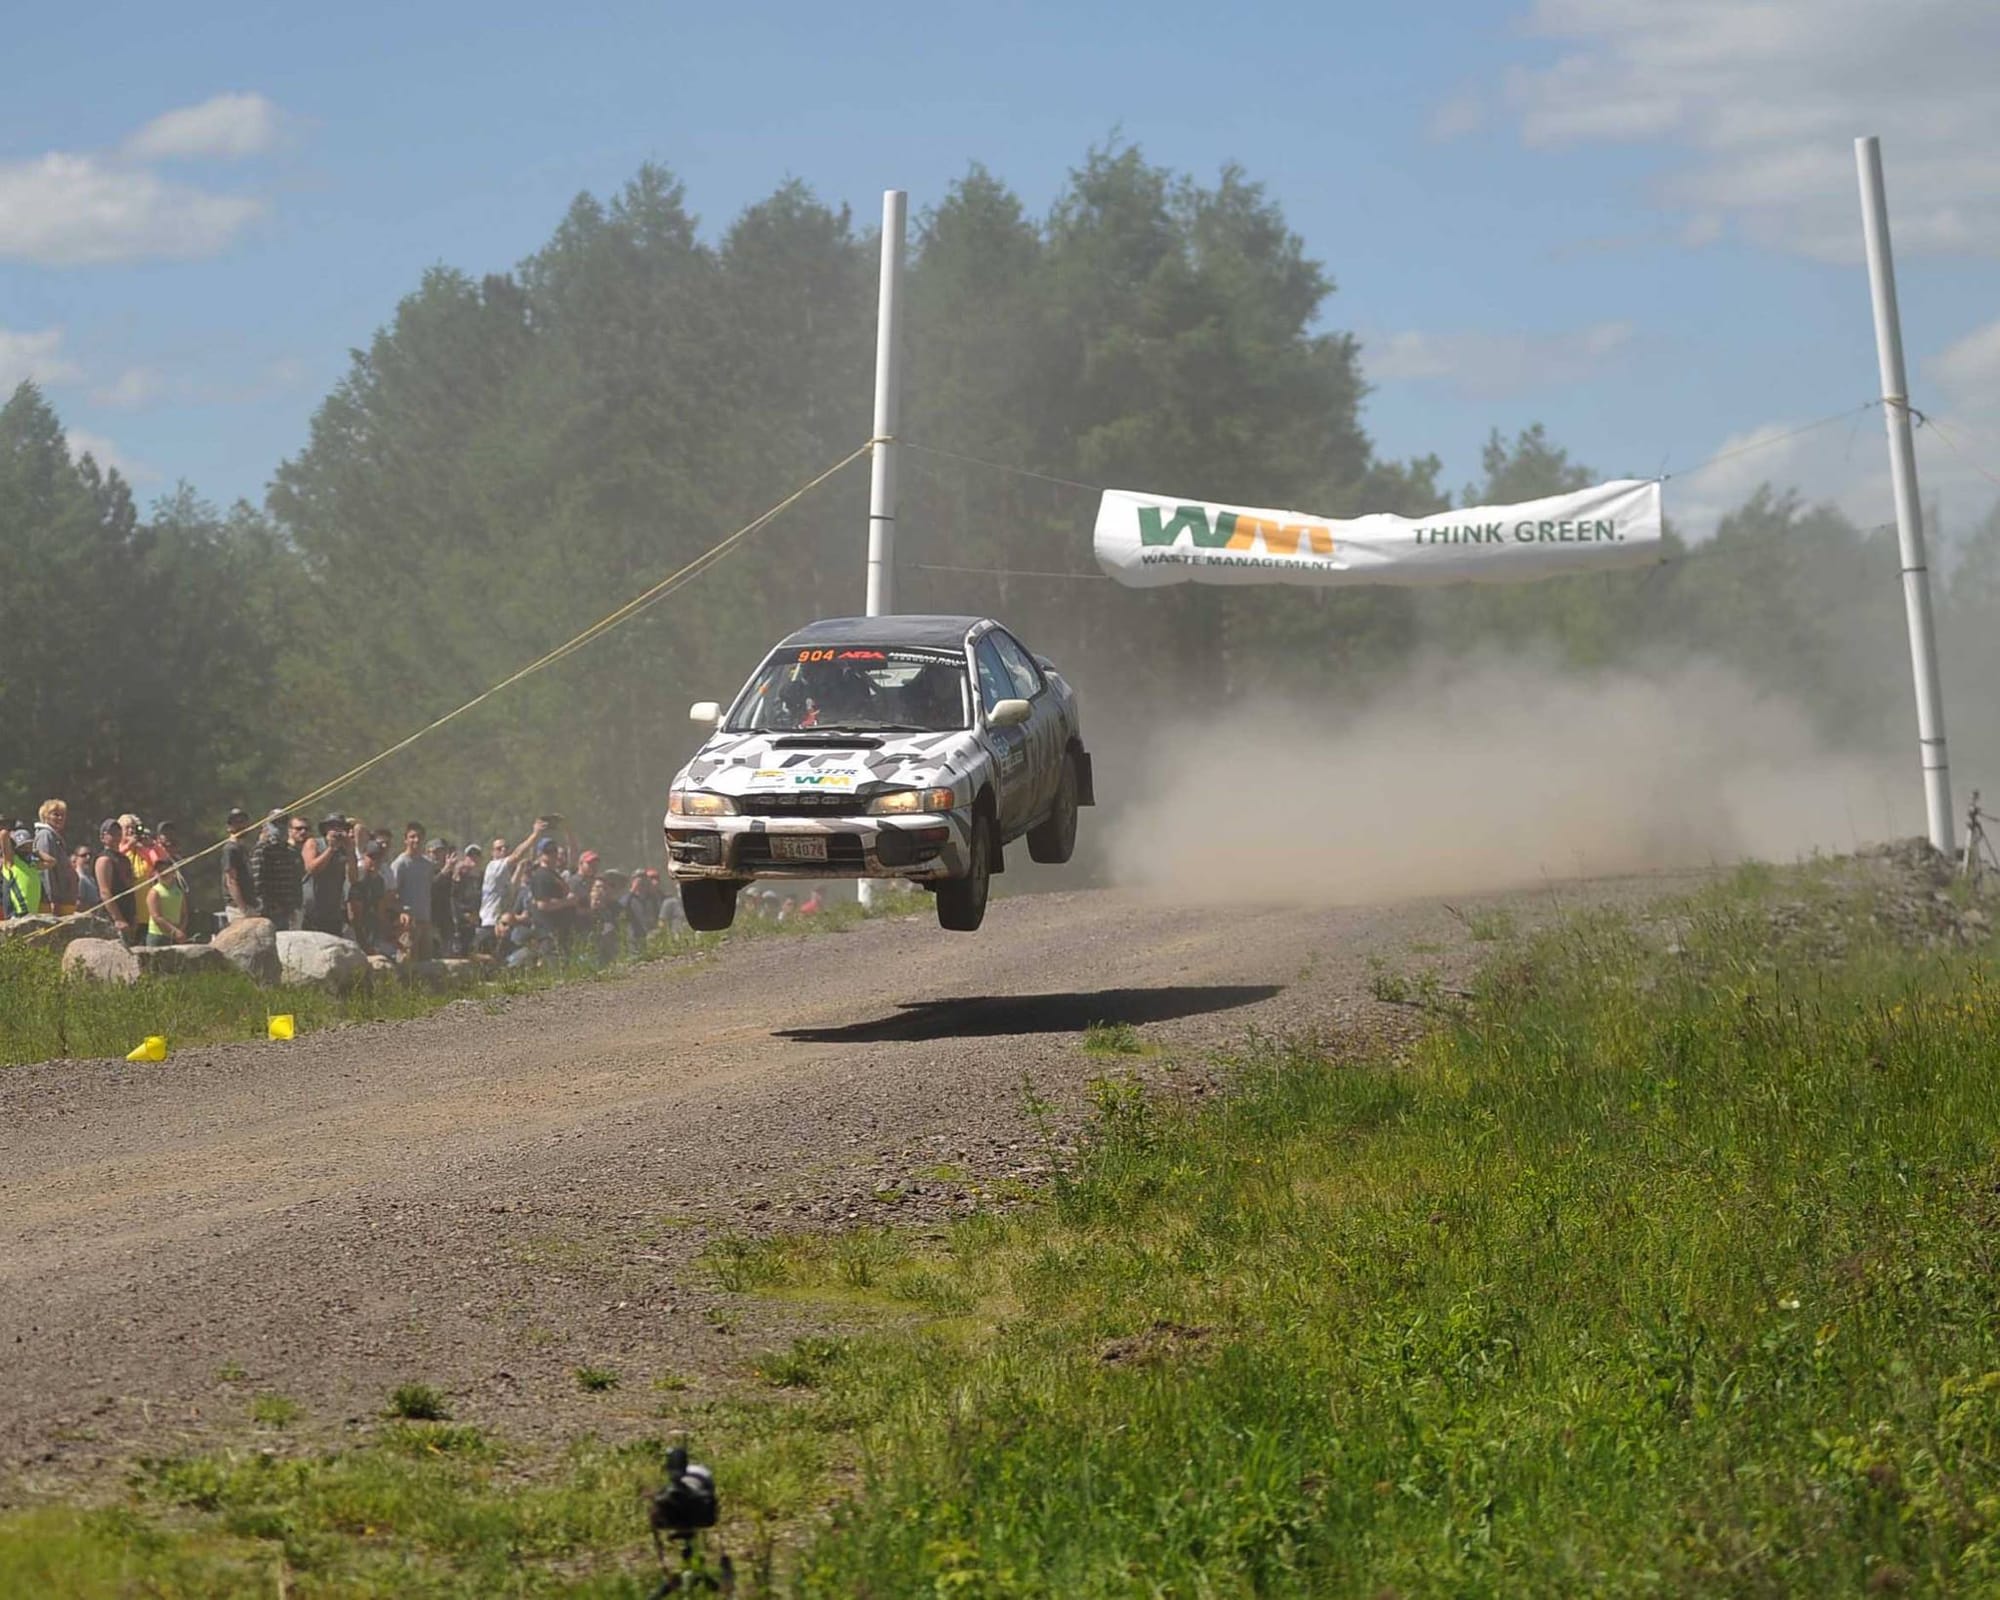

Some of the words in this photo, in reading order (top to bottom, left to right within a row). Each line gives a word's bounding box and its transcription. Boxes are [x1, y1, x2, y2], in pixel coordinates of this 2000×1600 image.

[1138, 506, 1334, 554] WM
[1413, 522, 1504, 544] THINK
[1514, 520, 1624, 543] GREEN.
[1141, 553, 1202, 566] WASTE
[1206, 555, 1333, 570] MANAGEMENT
[798, 650, 834, 662] 904
[795, 776, 850, 785] WM
